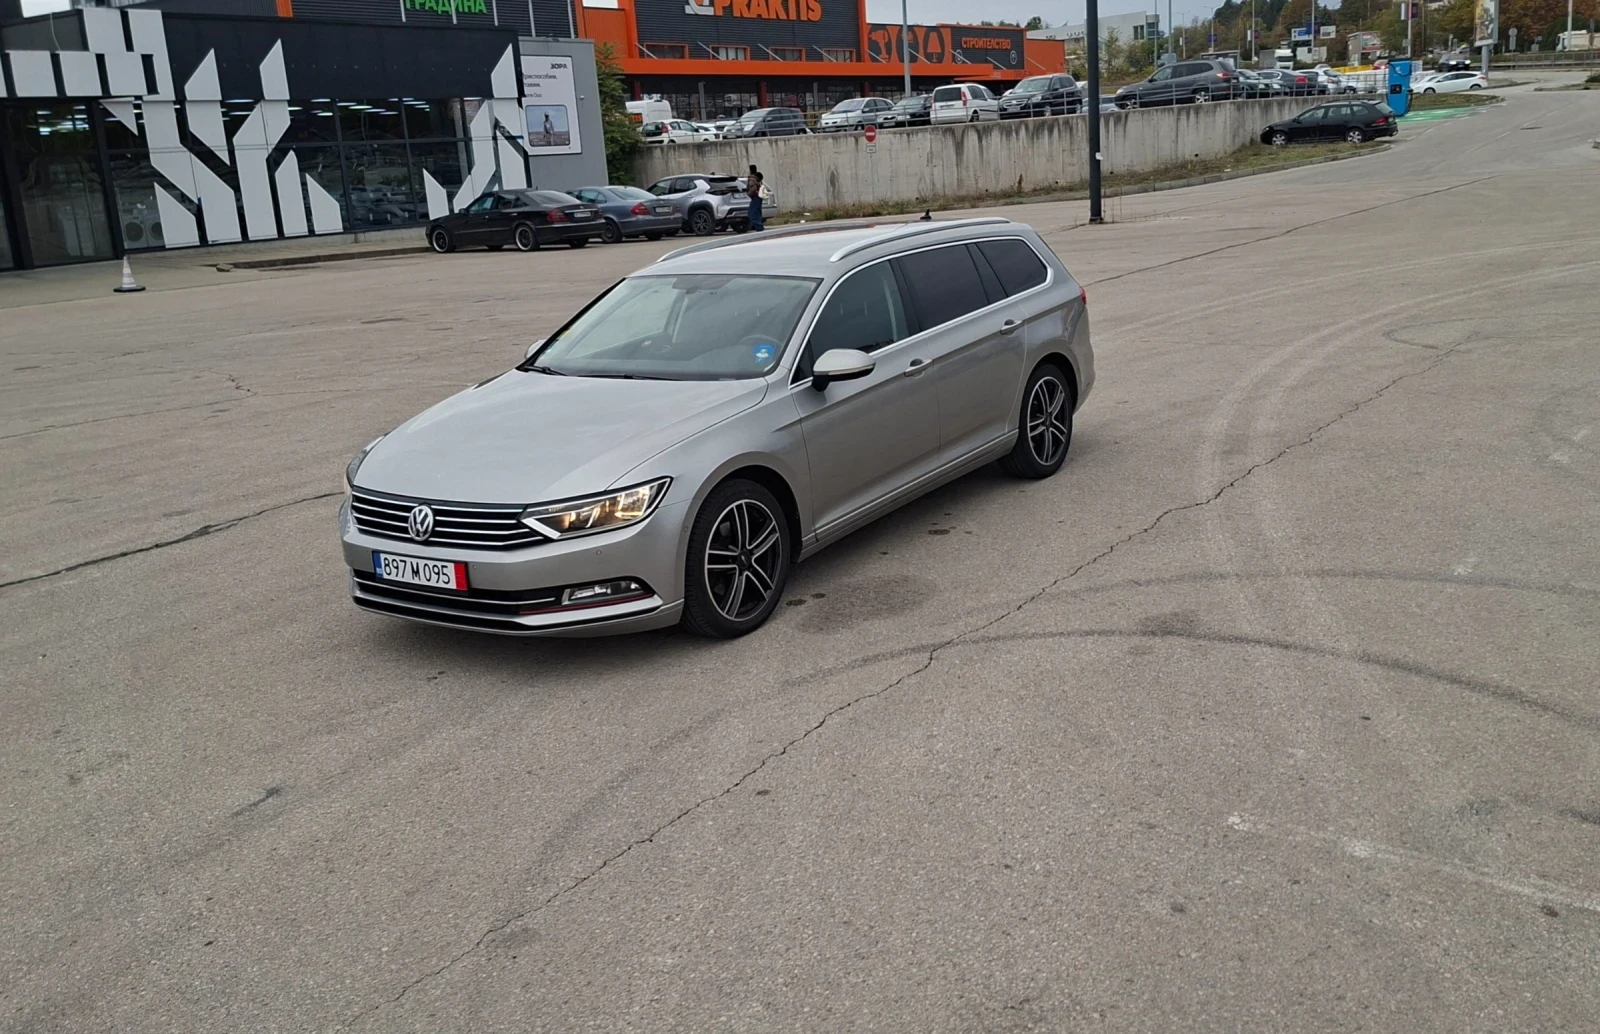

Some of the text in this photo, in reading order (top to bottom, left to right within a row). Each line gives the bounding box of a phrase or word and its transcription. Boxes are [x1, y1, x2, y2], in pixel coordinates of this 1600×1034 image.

[961, 37, 1011, 49] СТРОИТЕЛСТВО
[383, 557, 451, 585] 897 M 095
